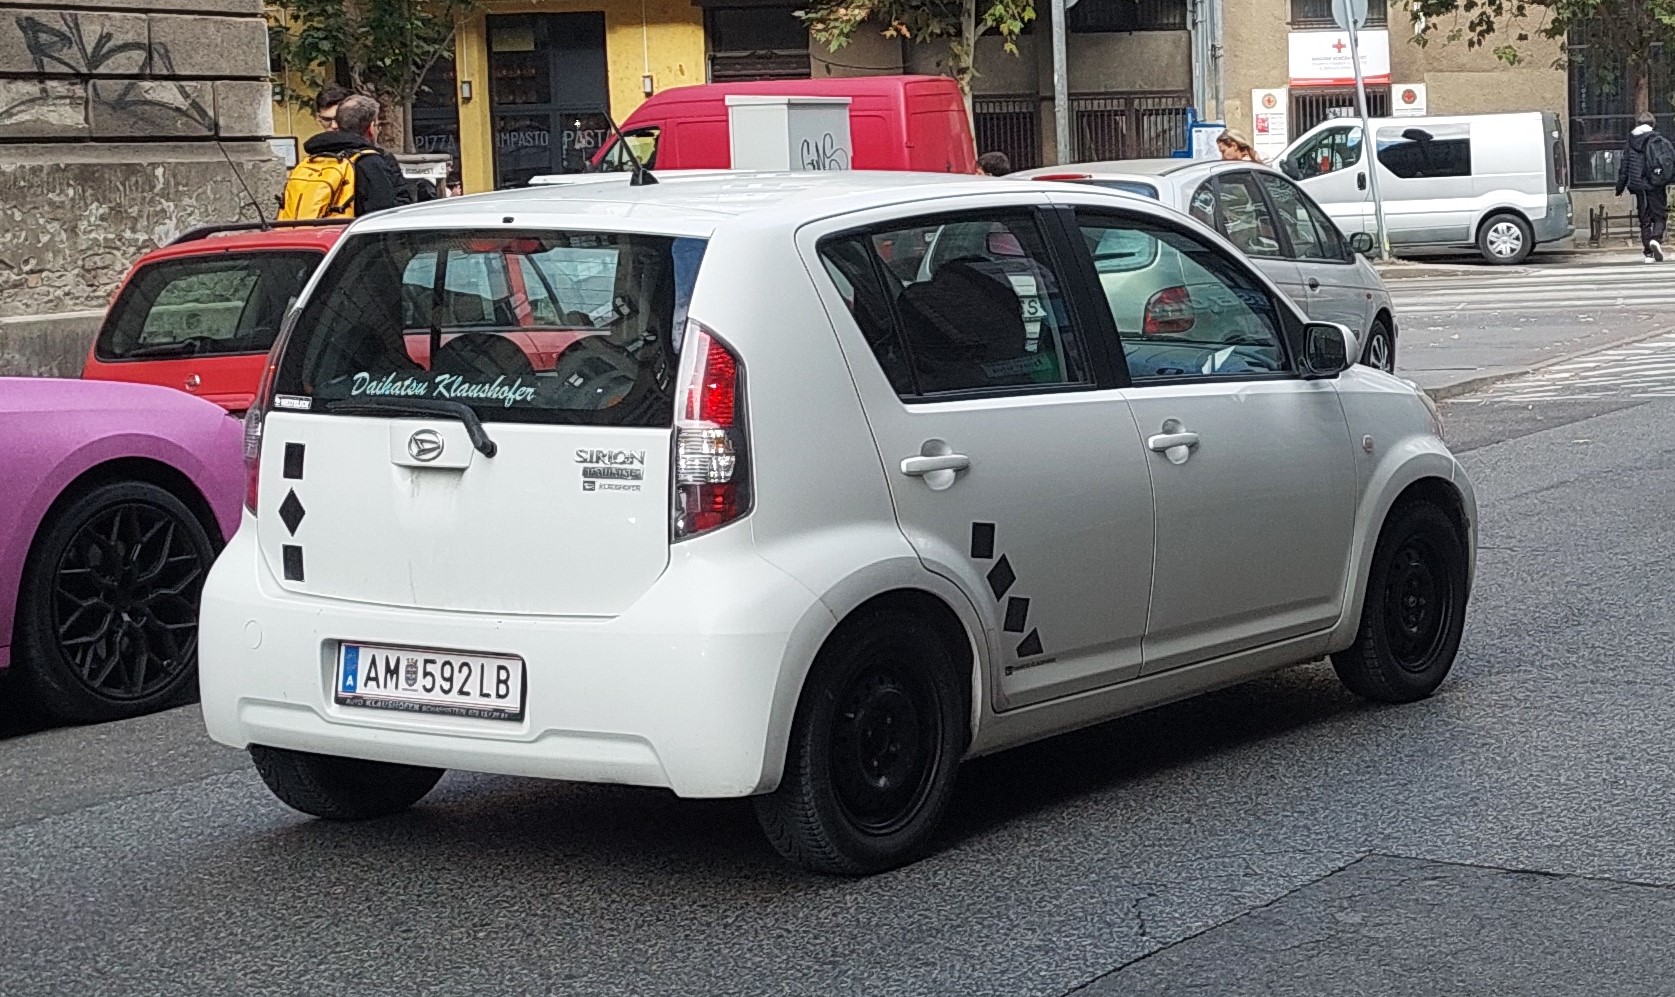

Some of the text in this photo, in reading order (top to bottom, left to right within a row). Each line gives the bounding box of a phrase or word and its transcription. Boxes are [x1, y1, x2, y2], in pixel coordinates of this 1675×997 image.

[351, 371, 537, 408] Daihatsu Klaushofer
[574, 449, 645, 465] SIRION
[345, 674, 354, 686] A
[364, 653, 400, 690] AM
